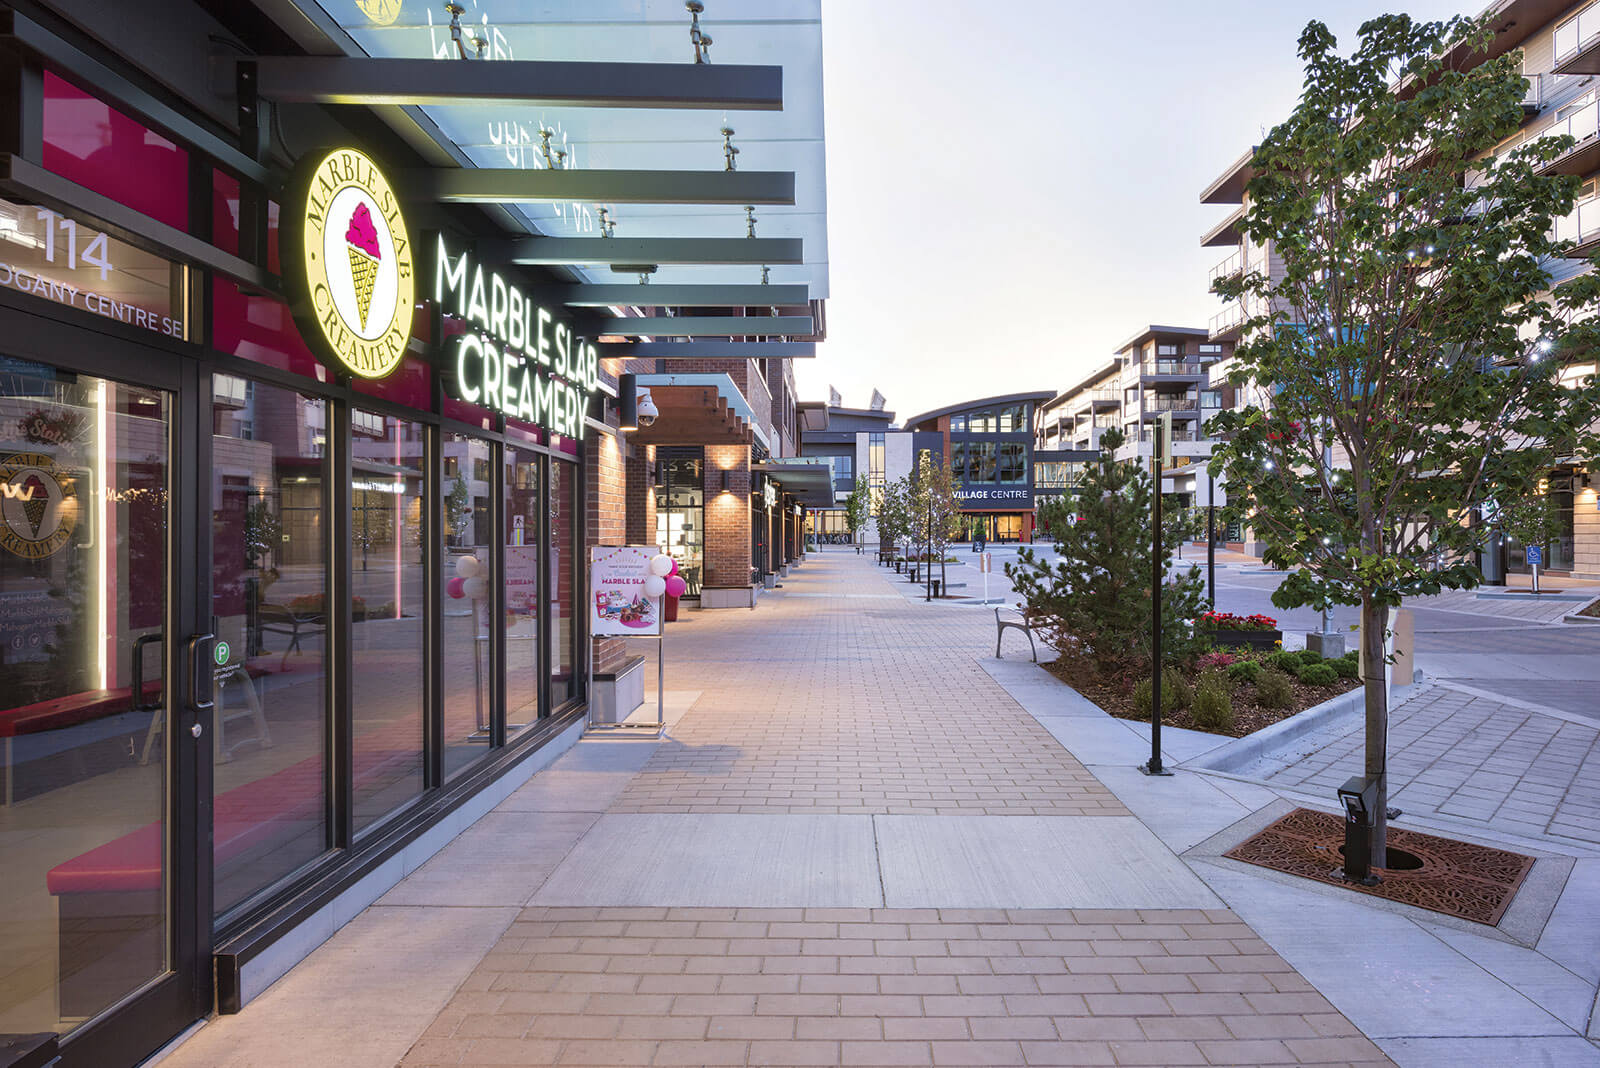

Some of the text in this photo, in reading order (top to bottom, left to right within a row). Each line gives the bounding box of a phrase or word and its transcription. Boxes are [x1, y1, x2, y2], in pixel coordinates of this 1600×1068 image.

[37, 208, 113, 281] 114
[307, 153, 411, 280] MARBLE SLAB
[85, 292, 159, 331] CENTRE
[162, 317, 183, 339] SE
[314, 282, 404, 372] CREAMERY
[435, 231, 599, 392] MARBLE SLAB
[457, 332, 590, 441] CREAMERY
[951, 490, 1028, 499] VILLAGE CENTRE
